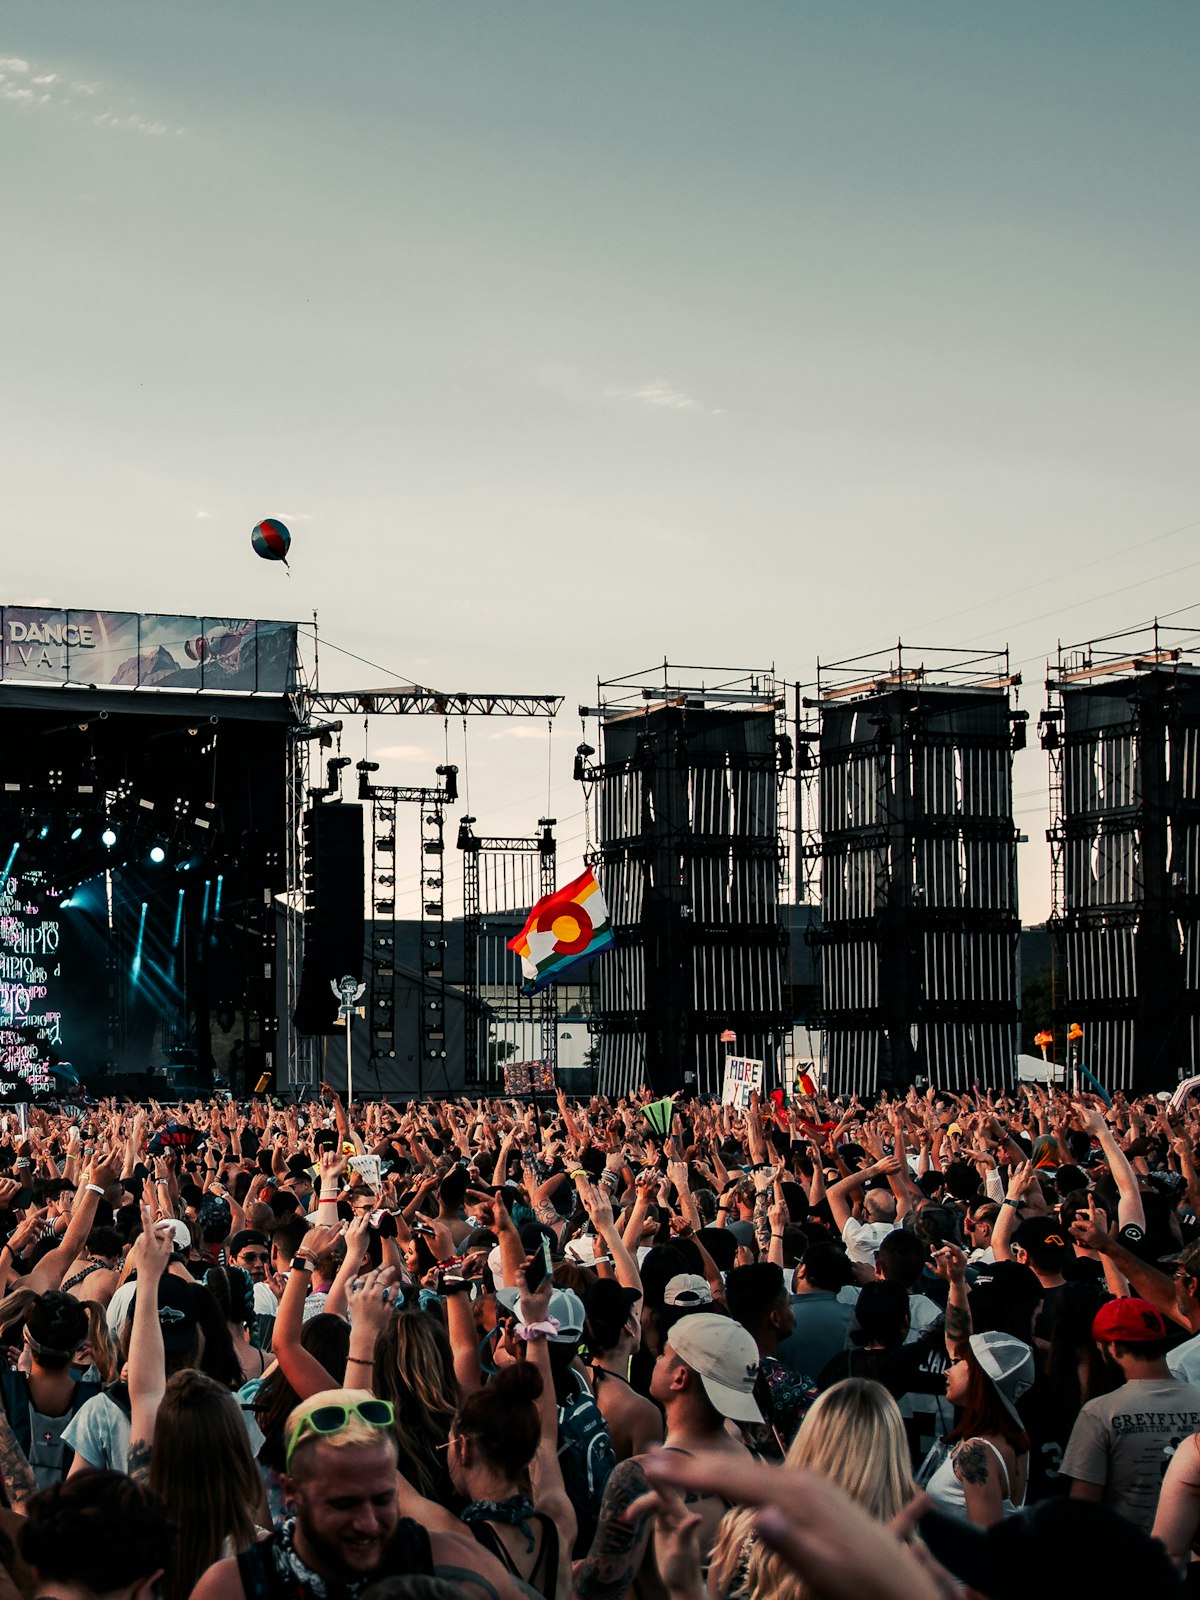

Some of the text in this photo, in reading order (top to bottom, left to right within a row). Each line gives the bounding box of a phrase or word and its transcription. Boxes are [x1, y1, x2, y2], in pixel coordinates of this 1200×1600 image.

[8, 621, 95, 648] DANCE
[729, 1060, 759, 1083] MORE
[1116, 1425, 1171, 1436] AMMUNITION
